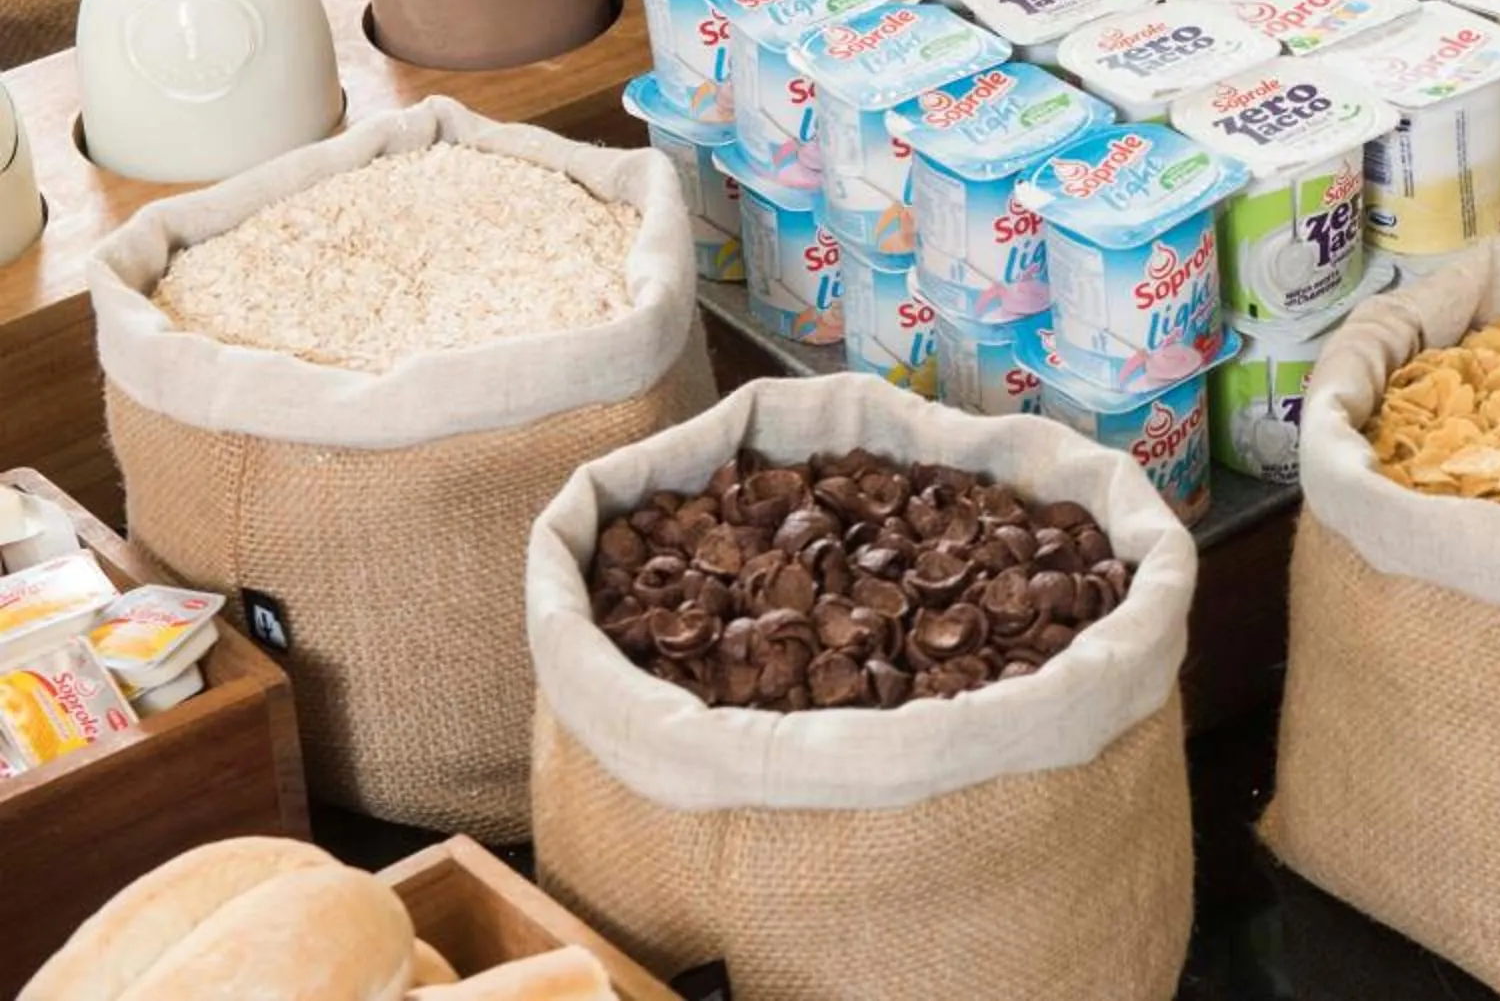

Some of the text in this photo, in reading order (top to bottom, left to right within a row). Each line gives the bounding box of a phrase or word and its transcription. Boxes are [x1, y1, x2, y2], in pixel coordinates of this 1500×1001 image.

[828, 10, 915, 57] Soprole
[926, 71, 1008, 127] Soprole
[1212, 79, 1281, 113] Soprole
[1065, 135, 1142, 197] Soprole
[1132, 408, 1202, 466] Sopro
[54, 671, 99, 736] Soprole
